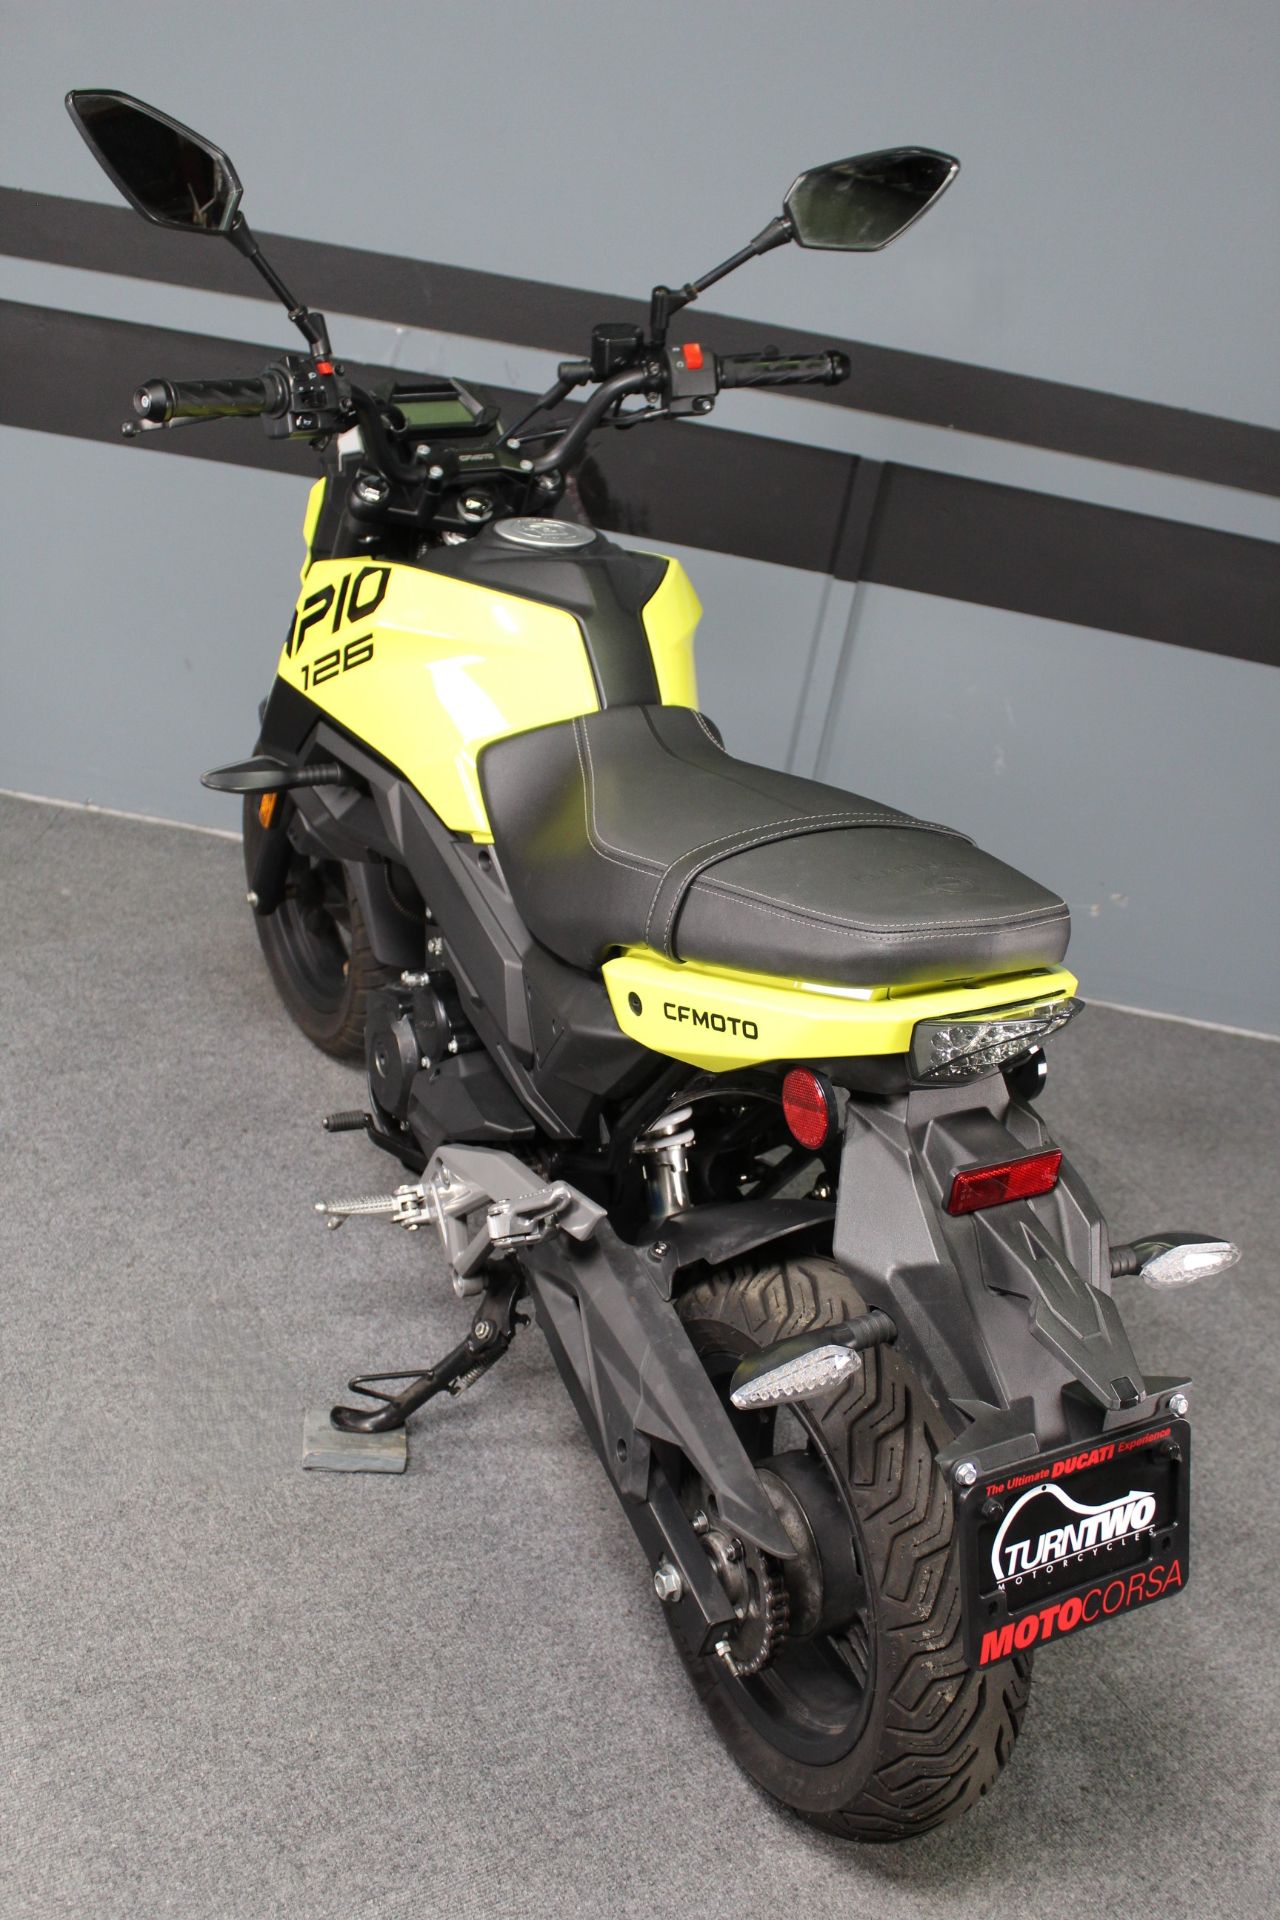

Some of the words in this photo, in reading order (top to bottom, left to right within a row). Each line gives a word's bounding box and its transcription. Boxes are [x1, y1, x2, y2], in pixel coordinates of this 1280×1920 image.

[301, 633, 374, 691] 126
[664, 1002, 758, 1040] CFMOTO
[986, 1484, 1004, 1497] The
[1007, 1469, 1050, 1489] Ultimate
[1051, 1445, 1115, 1479] DUCATI
[1118, 1428, 1171, 1453] Experience
[998, 1527, 1156, 1592] MOTORCYCLES
[1004, 1496, 1156, 1576] TURNTWO
[979, 1559, 1182, 1665] MOTOCORSA
